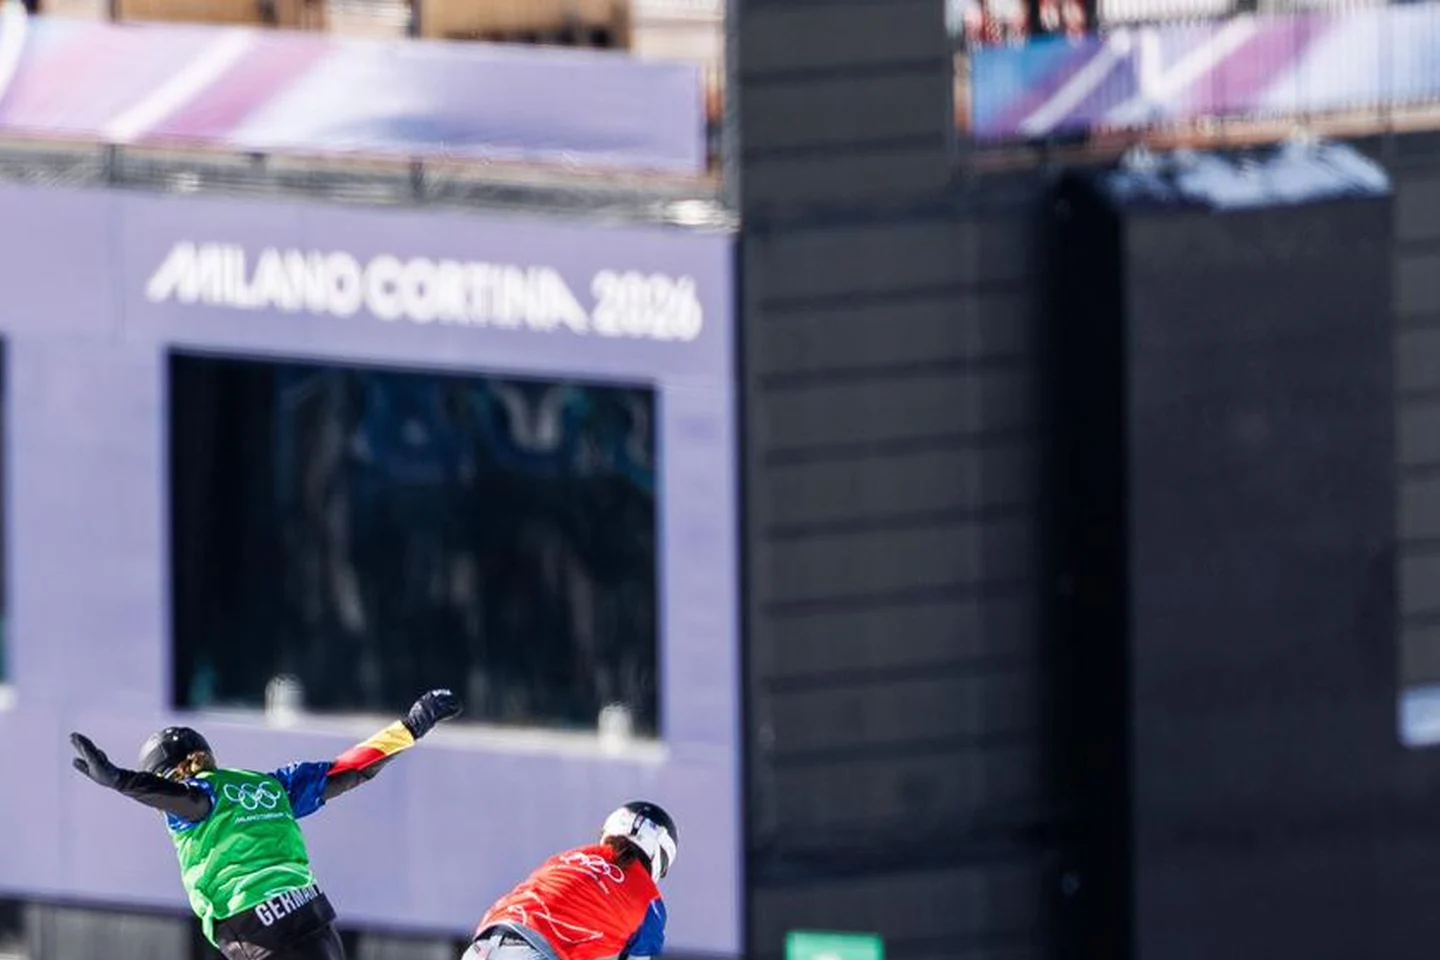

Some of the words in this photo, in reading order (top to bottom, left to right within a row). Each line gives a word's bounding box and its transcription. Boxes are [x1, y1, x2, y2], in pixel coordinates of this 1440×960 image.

[146, 241, 361, 319] MILANO
[365, 254, 590, 335] CORTINA
[591, 270, 703, 341] 2026
[254, 884, 321, 927] GERMAN
